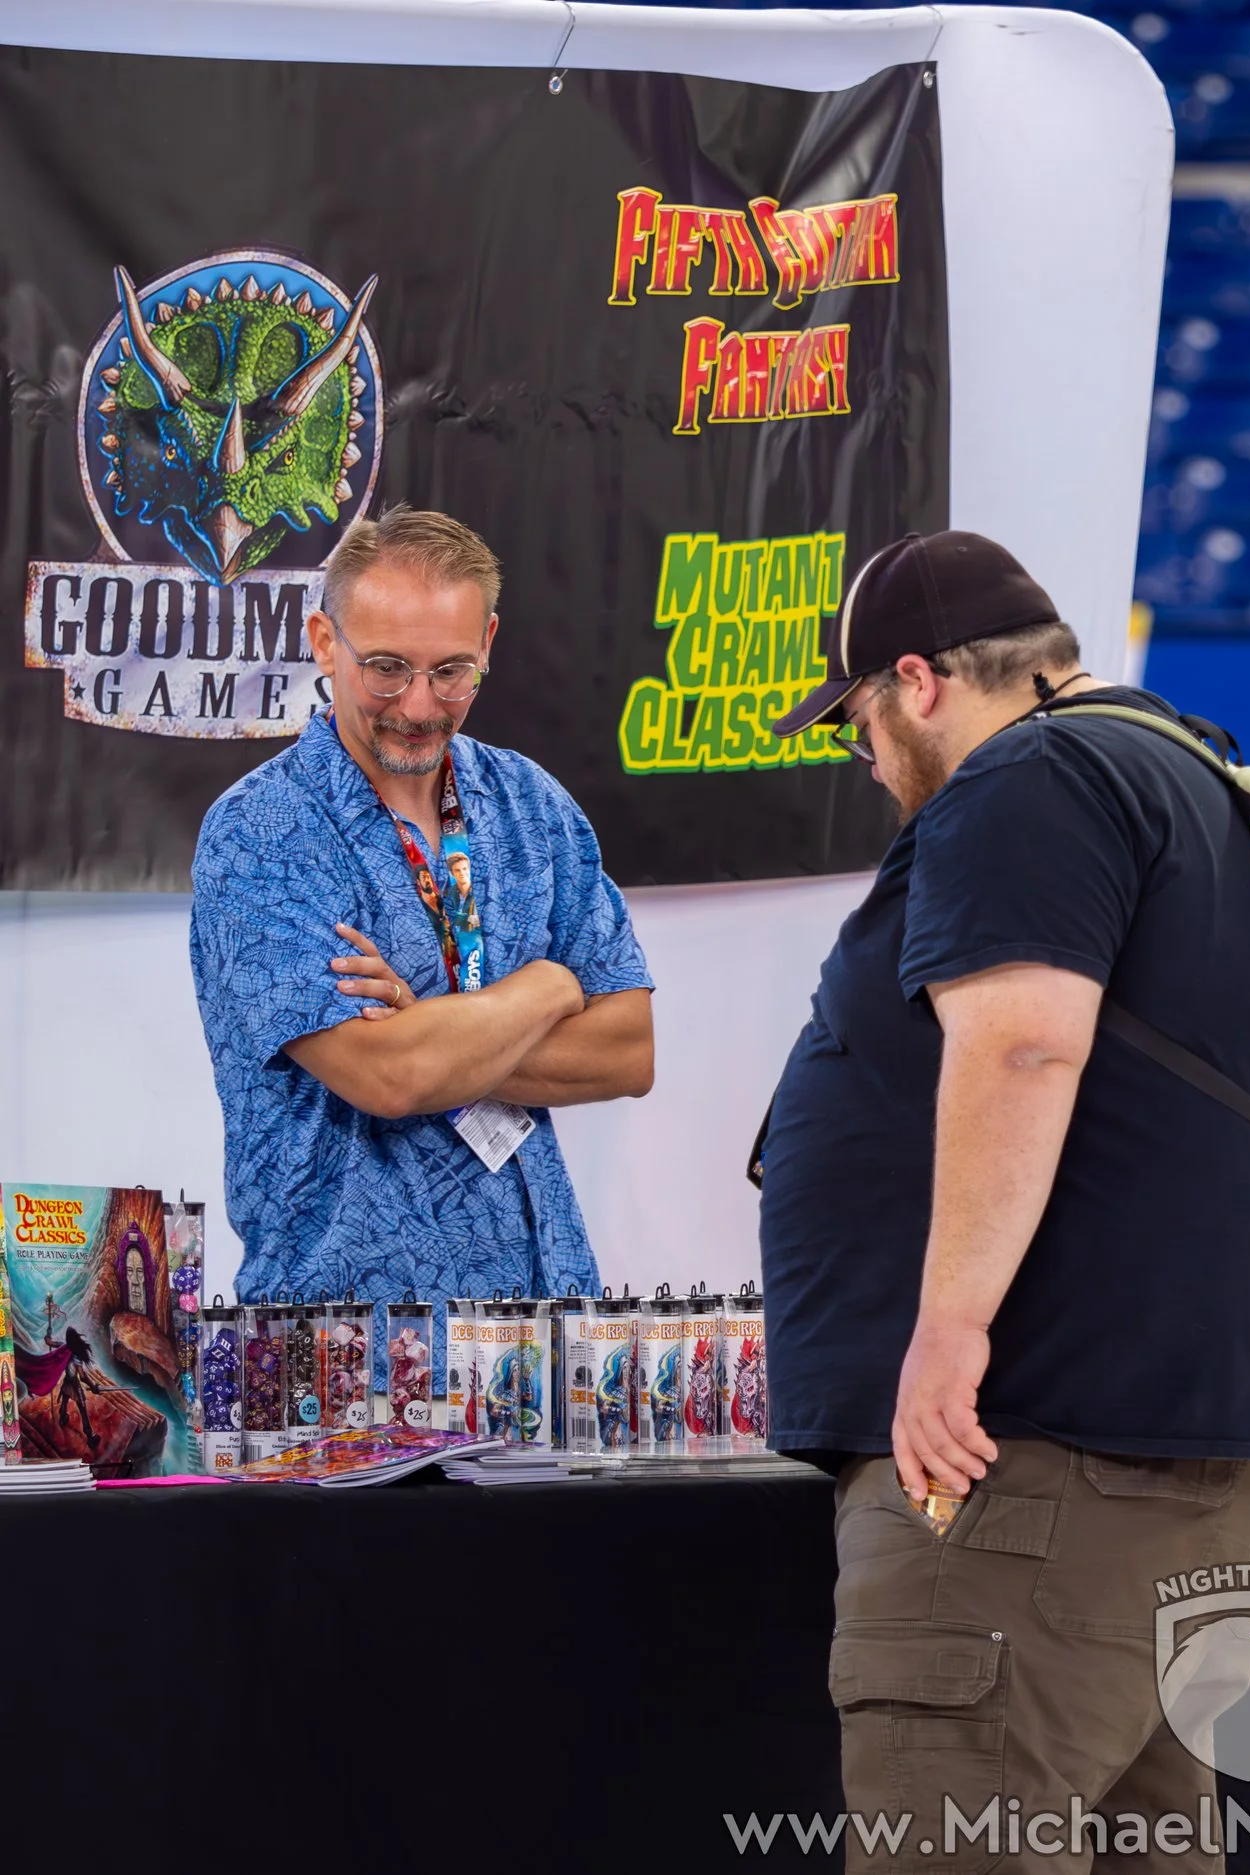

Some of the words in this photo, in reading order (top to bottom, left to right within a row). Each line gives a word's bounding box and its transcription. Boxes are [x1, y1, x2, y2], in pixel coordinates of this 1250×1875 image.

[608, 186, 768, 305] FIFTH
[672, 316, 851, 435] FANTASY
[654, 531, 846, 629] MUTANT
[41, 575, 315, 663] GOODM
[666, 611, 828, 700] CRAWL
[13, 1193, 84, 1215] DUNGEON
[22, 1211, 79, 1230] CRAWL
[15, 1224, 87, 1245] CLASSICS
[37, 1250, 67, 1260] PLAYING
[452, 1325, 473, 1341] DCC
[496, 1327, 519, 1343] RPG
[694, 1322, 715, 1338] RPG
[740, 1321, 763, 1337] RPG
[302, 1402, 318, 1415] $25
[352, 1409, 367, 1422] $25
[407, 1407, 426, 1420] $25
